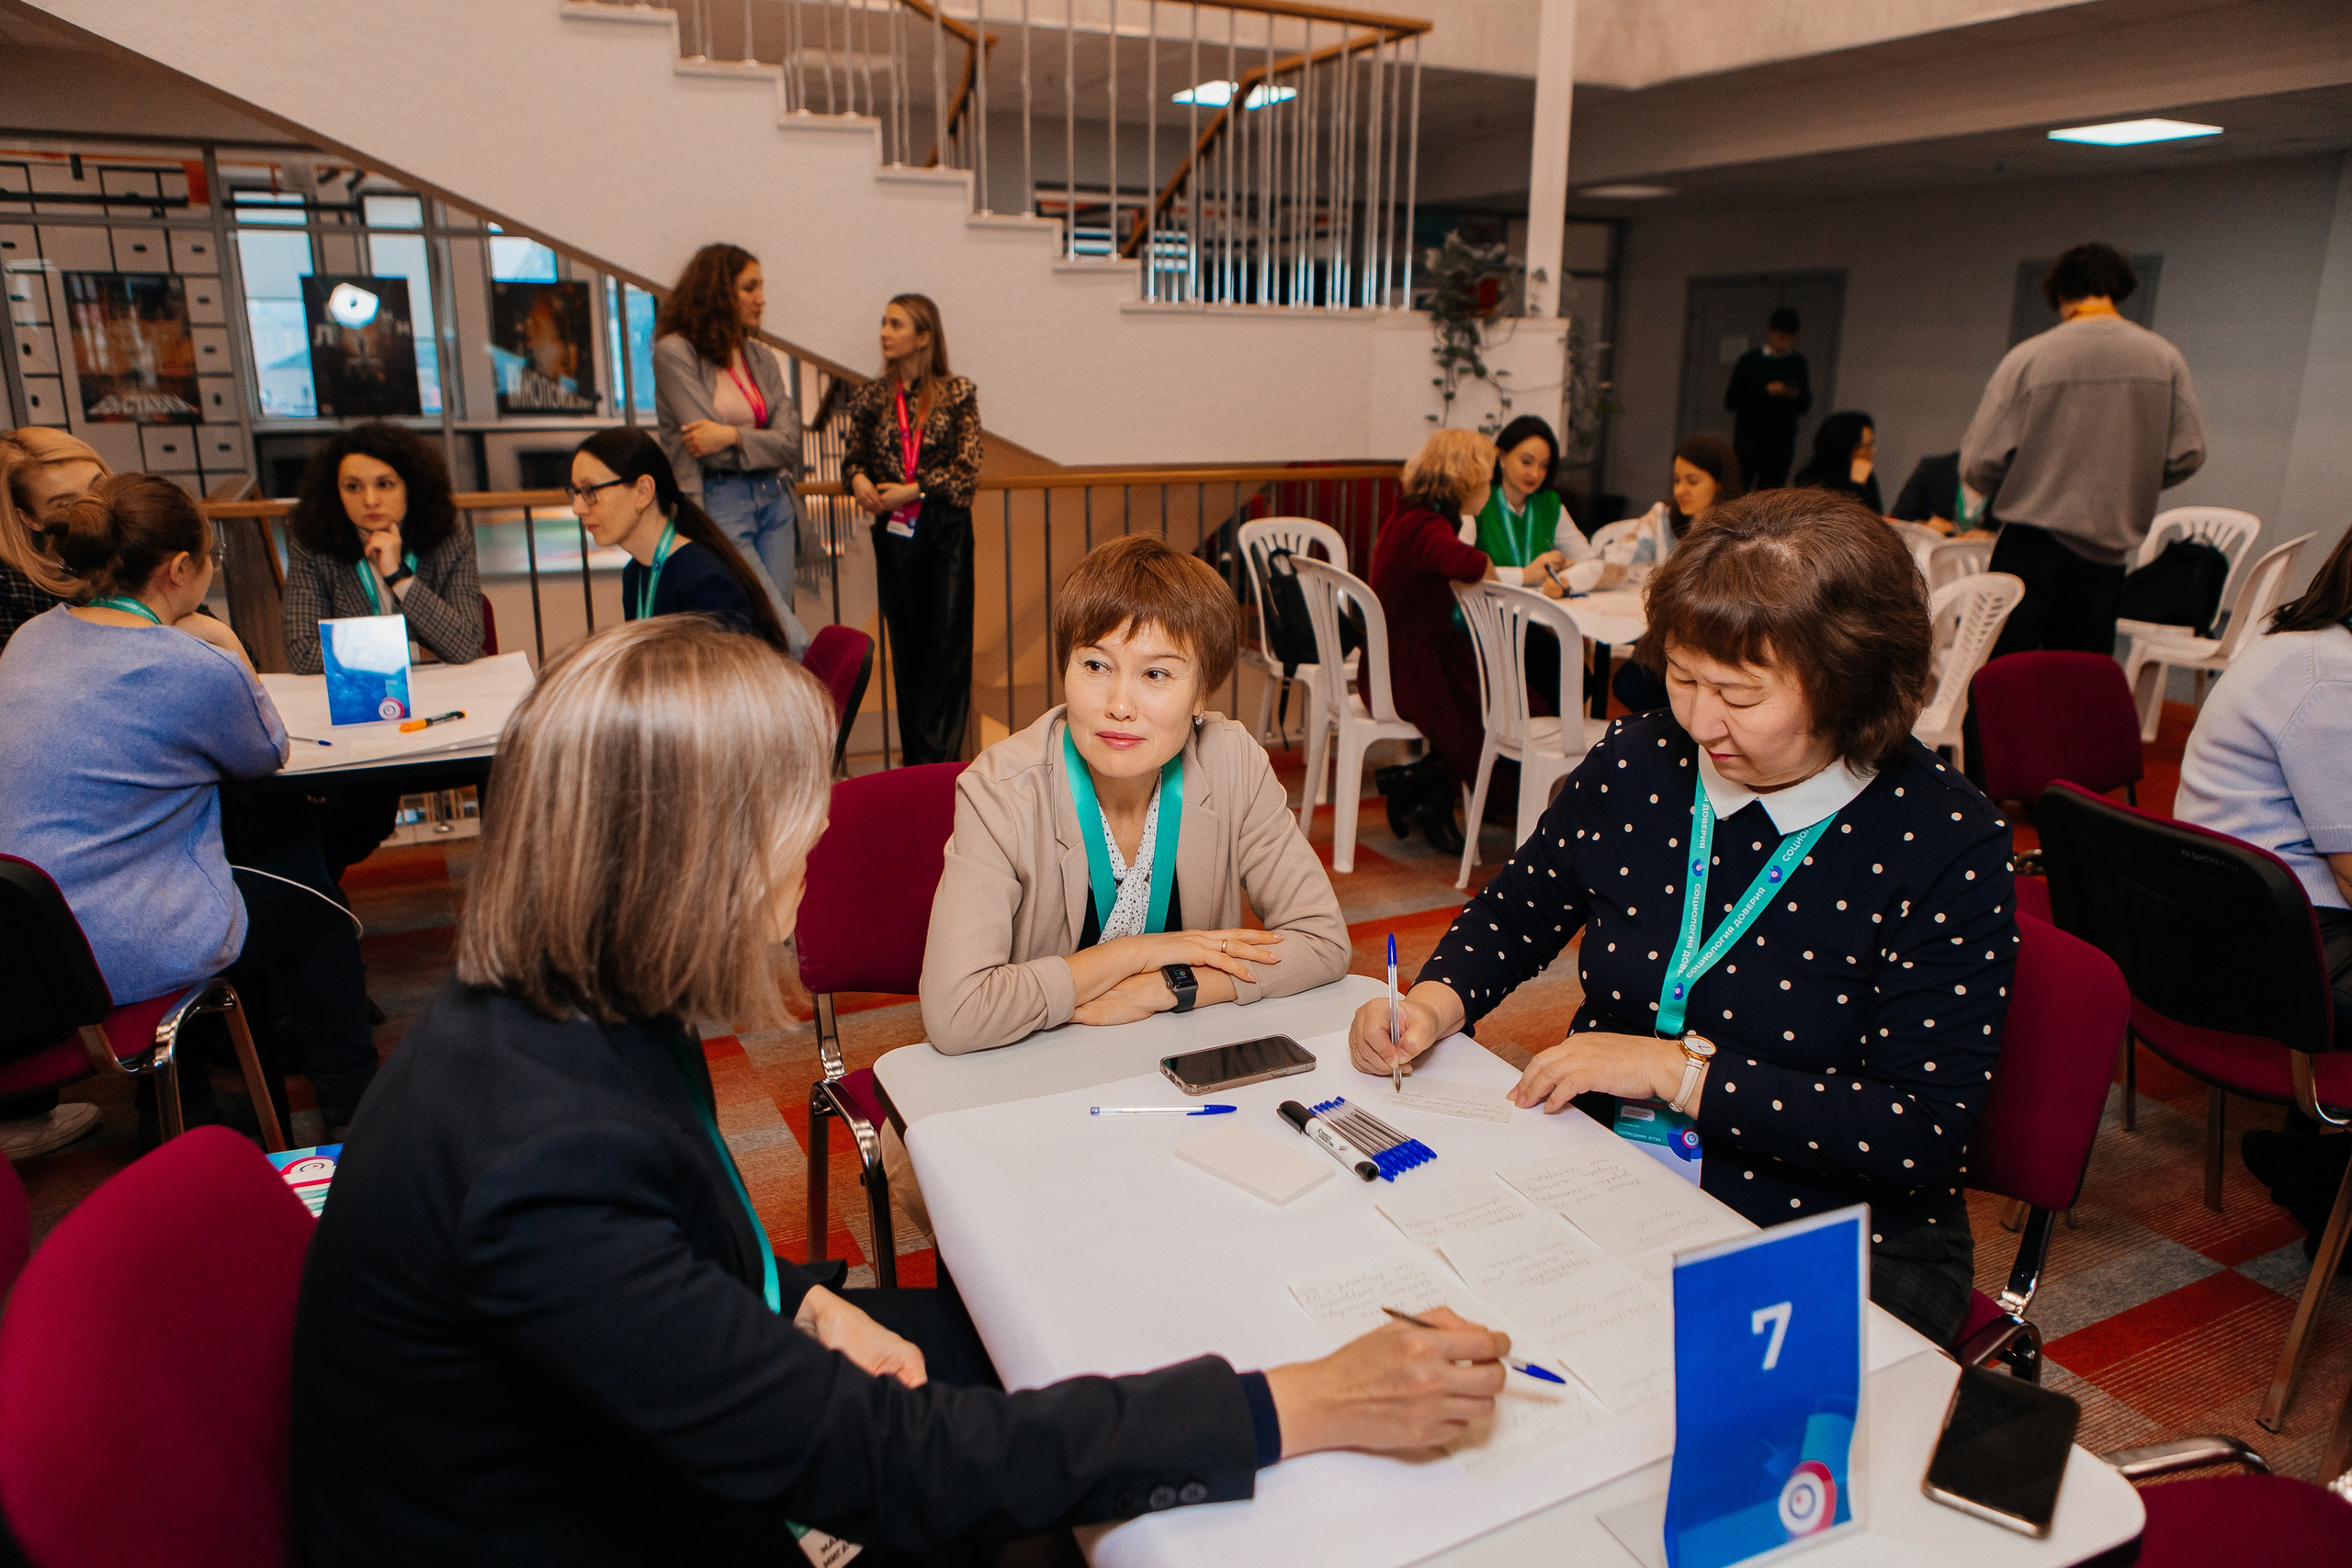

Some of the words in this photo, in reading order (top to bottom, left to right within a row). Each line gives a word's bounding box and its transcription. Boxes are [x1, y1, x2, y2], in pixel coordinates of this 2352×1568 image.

[1699, 803, 1710, 849] ДОВЕРИЯ
[1686, 925, 1735, 978] СОЦИОЛОГИЯ
[1734, 886, 1766, 929] ДОВЕРИЯ
[1687, 884, 1701, 949] СОЦИОЛОГИЯ
[1617, 1130, 1647, 1139] СОТРУДНИК
[1648, 1134, 1661, 1143] ВУЗА
[1751, 1301, 1793, 1371] 7
